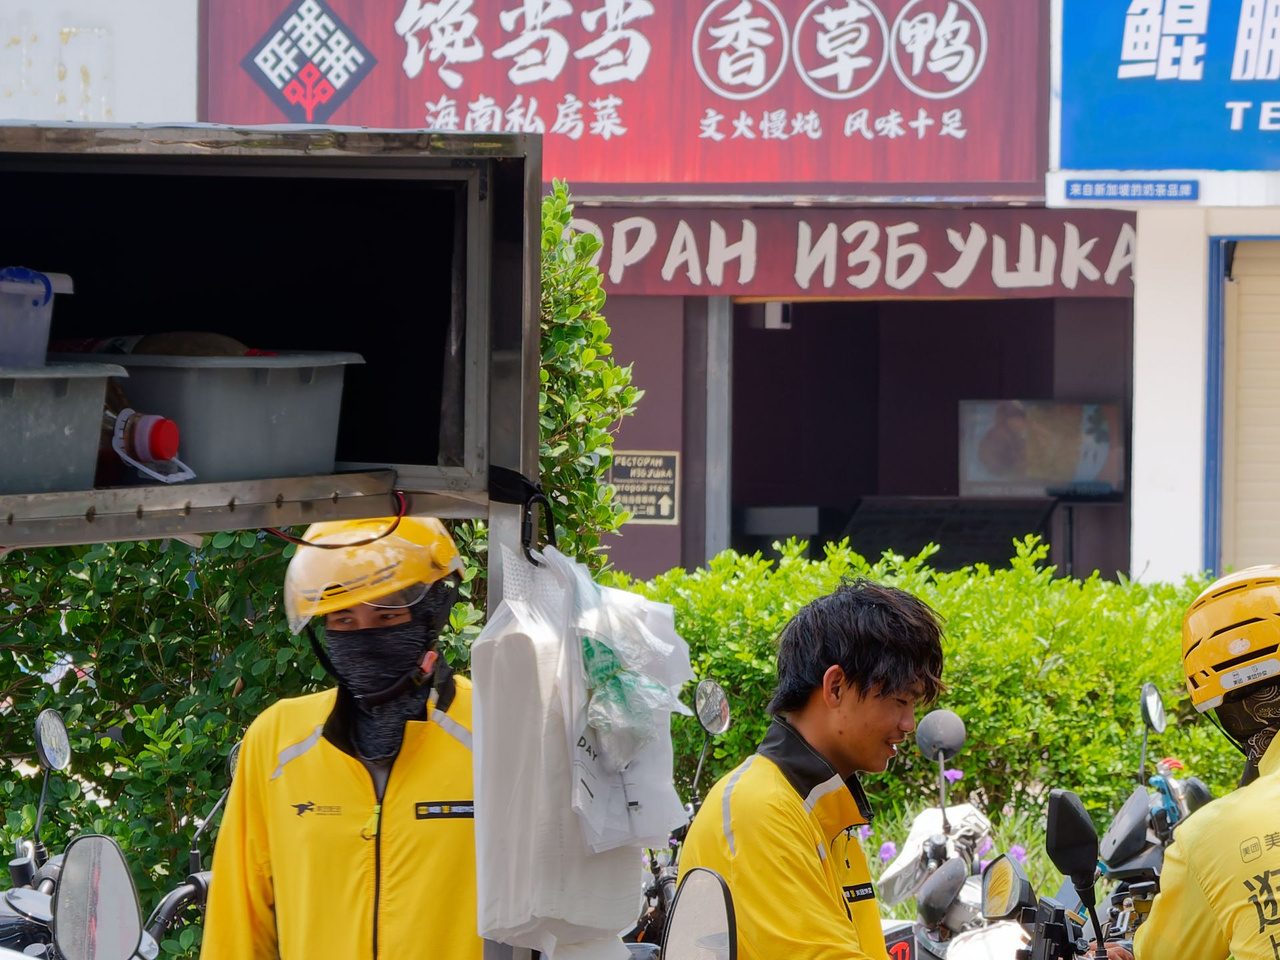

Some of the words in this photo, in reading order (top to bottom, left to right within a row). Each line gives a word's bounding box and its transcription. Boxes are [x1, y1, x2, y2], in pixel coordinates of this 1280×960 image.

[706, 0, 976, 91] 香草鸭
[425, 93, 628, 141] 海南私房菜
[697, 108, 823, 141] 文火慢炖
[844, 108, 968, 140] 风味十足
[614, 456, 663, 467] РЕСТОРАН
